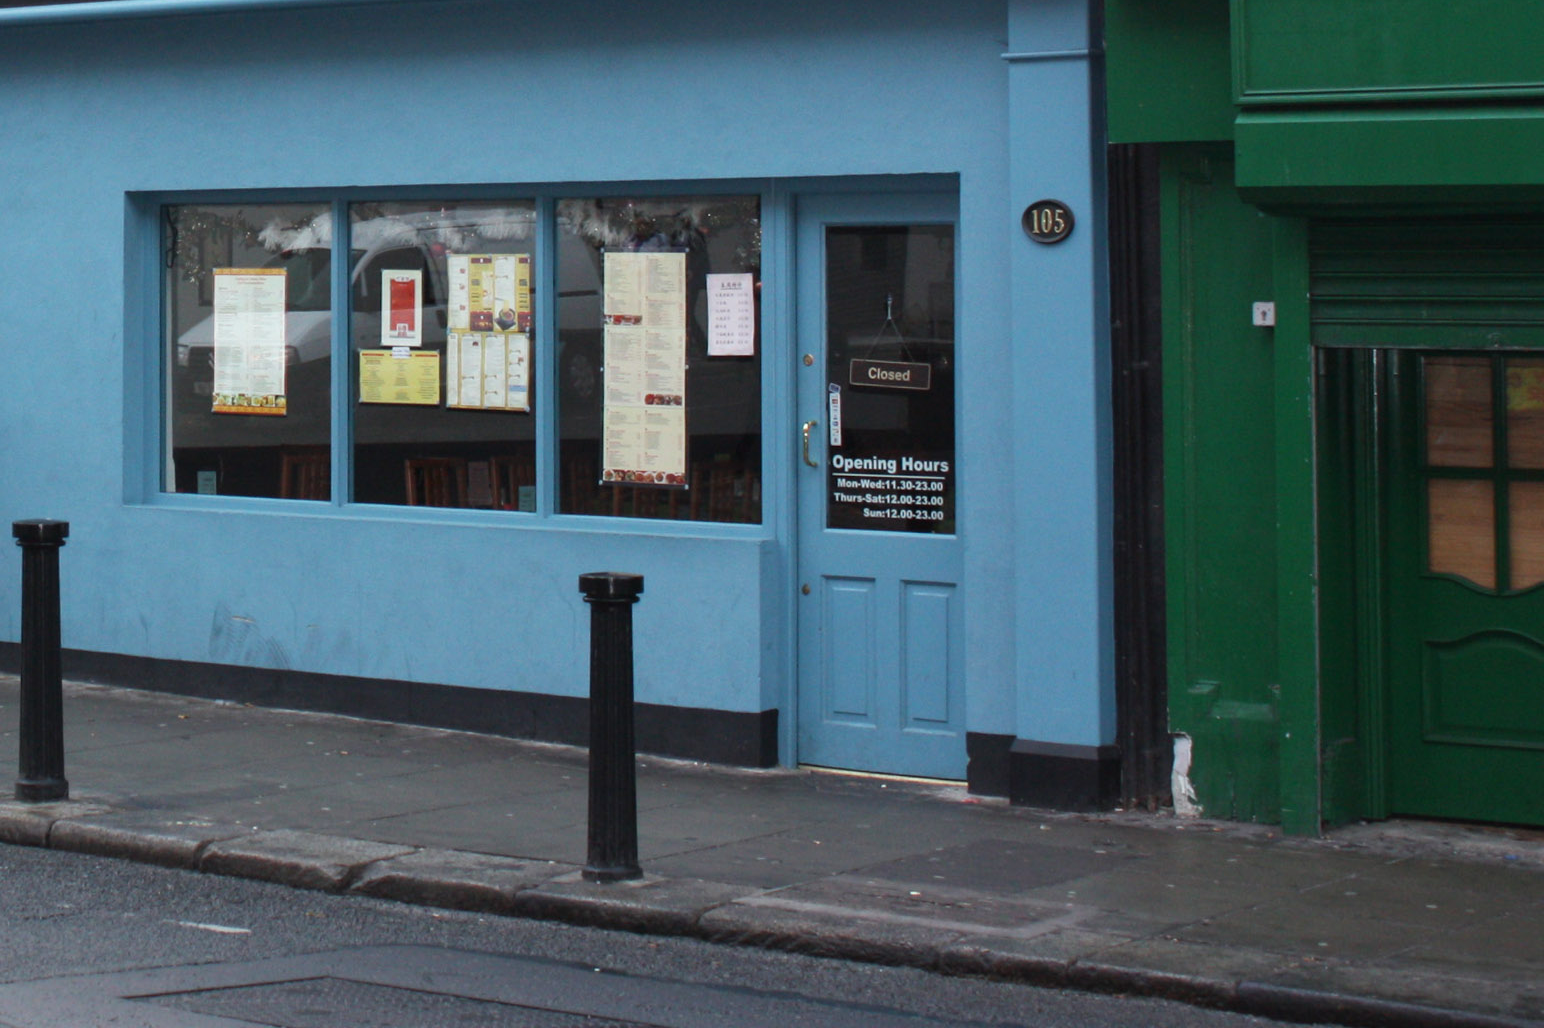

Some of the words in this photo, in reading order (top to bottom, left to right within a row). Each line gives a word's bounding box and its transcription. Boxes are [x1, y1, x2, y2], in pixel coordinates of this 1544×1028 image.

[1031, 208, 1065, 234] 105
[868, 367, 911, 382] Closed
[832, 455, 897, 474] Opening
[902, 457, 949, 472] Hours
[837, 478, 943, 491] Mon-Wed:11.30-23.00
[834, 493, 943, 506] Thurs-Sat:12.00-23.00
[863, 508, 944, 520] Sun:12.00-23.00
